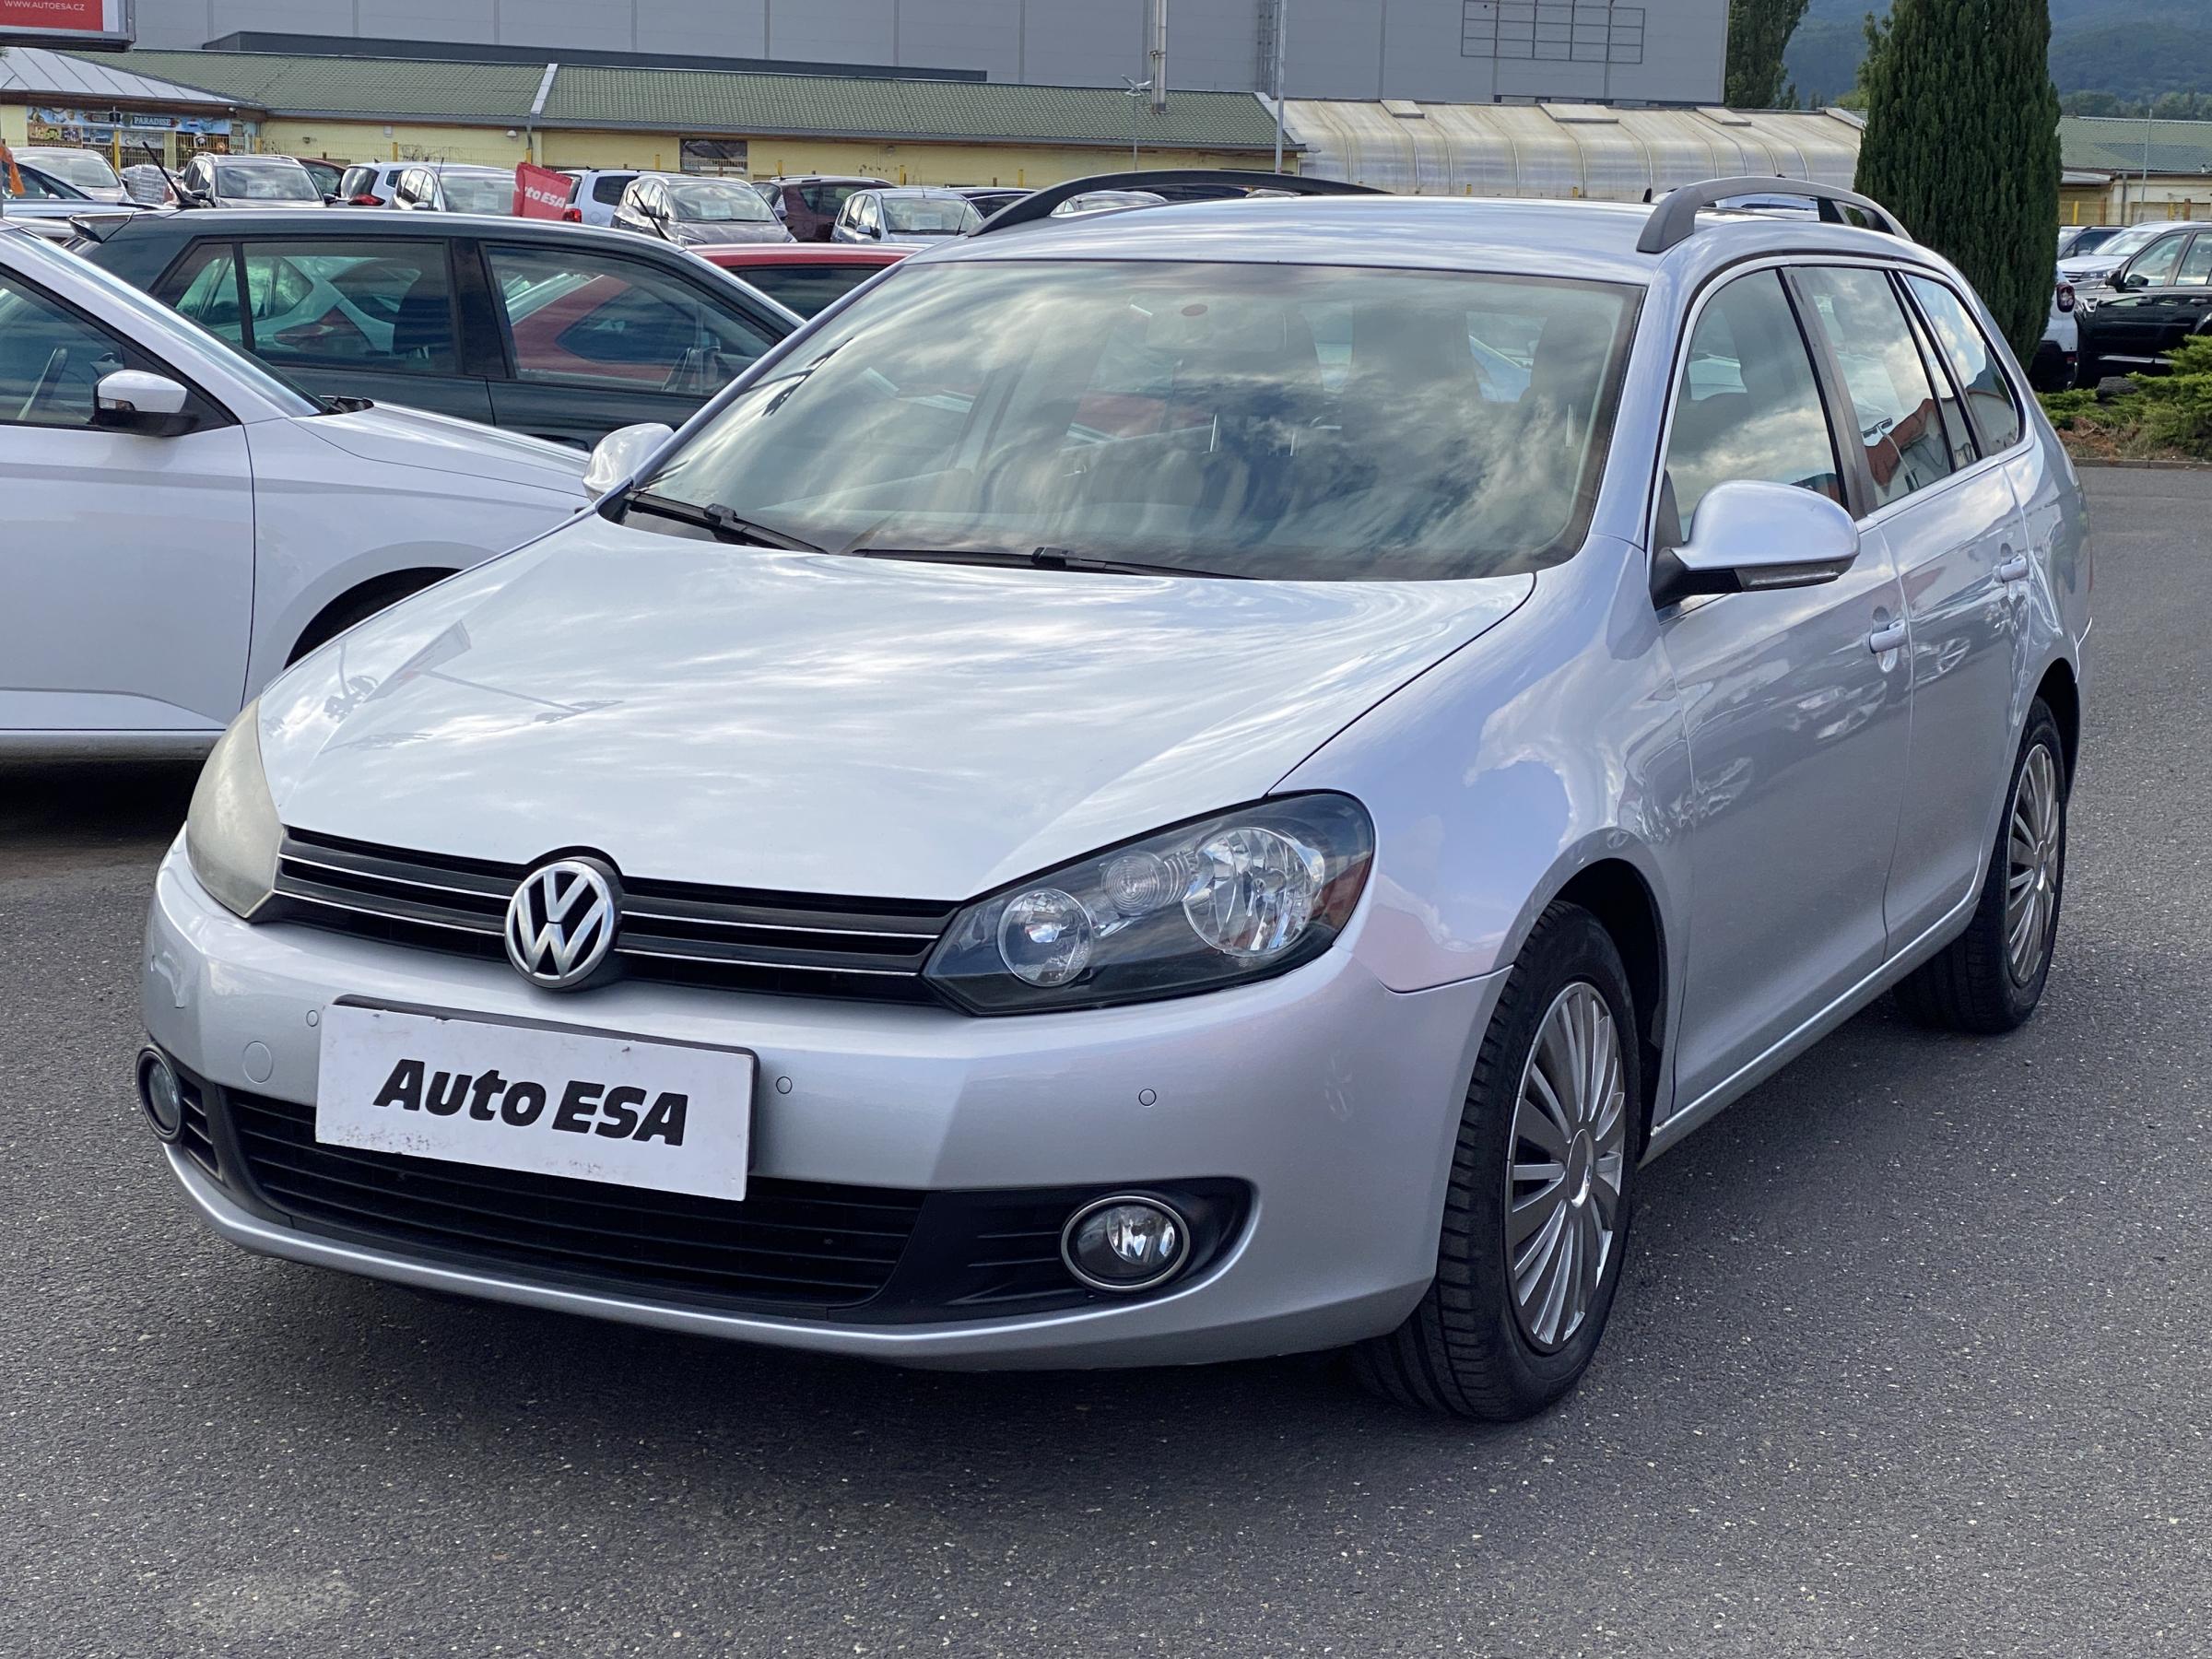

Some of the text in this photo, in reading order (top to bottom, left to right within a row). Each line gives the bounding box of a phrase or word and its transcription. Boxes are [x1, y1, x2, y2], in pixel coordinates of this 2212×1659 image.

[5, 0, 85, 11] WWW.AUTOESA.CZ
[134, 115, 171, 126] PARADISE
[540, 192, 566, 208] ESA
[506, 860, 615, 981] VW
[372, 1058, 688, 1147] Auto ESA
